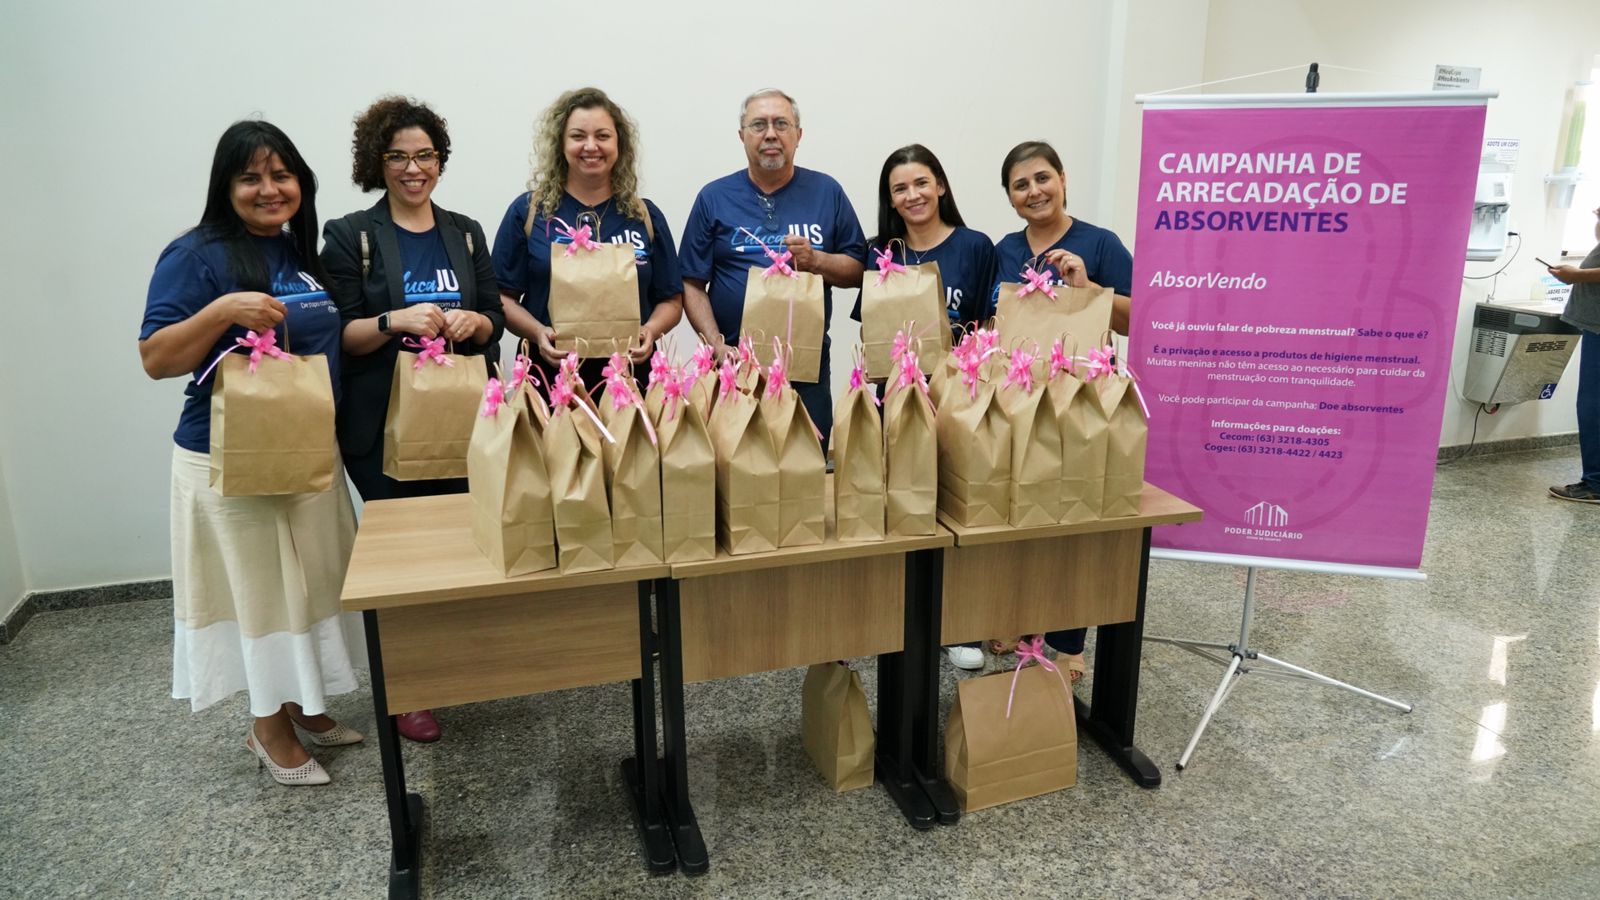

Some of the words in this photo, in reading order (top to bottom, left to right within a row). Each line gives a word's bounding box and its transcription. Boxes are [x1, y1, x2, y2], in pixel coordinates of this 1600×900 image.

[1158, 152, 1316, 174] CAMPANHA
[1323, 152, 1362, 174] DE
[1156, 178, 1362, 209] ARRECADAÇÃO
[1369, 182, 1408, 204] DE
[1154, 210, 1348, 232] ABSORVENTES
[1149, 270, 1267, 290] AbsorVendo
[1152, 320, 1174, 330] Você
[1176, 322, 1185, 332] já
[1187, 322, 1215, 331] ouviu
[1216, 323, 1240, 332] falar
[1241, 324, 1254, 333] de
[1256, 325, 1296, 335] pobreza
[1299, 327, 1356, 337] menstrual?
[1358, 328, 1381, 338] Sabe
[1394, 332, 1414, 340] que
[1417, 330, 1428, 339] é?
[1153, 344, 1159, 354] É
[1169, 346, 1210, 357] privação
[1262, 350, 1307, 360] produtos
[1310, 352, 1322, 360] de
[1324, 352, 1362, 362] higiene
[1365, 355, 1420, 364] menstrual.
[1147, 357, 1176, 367] Muitas
[1178, 359, 1216, 368] meninas
[1218, 360, 1235, 369] não
[1238, 361, 1255, 370] têm
[1258, 363, 1289, 372] acesso
[1305, 365, 1355, 374] necessário
[1356, 368, 1378, 376] para
[1380, 368, 1410, 377] cuidar
[1412, 369, 1425, 377] da
[1207, 372, 1266, 384] menstruação
[1291, 376, 1356, 387] tranquilidade.
[1158, 394, 1180, 403] Você
[1182, 395, 1205, 404] pode
[1207, 396, 1250, 406] participar
[1252, 398, 1263, 406] da
[1266, 399, 1317, 410] campanha:
[1320, 402, 1339, 410] Doe
[1341, 403, 1404, 414] absorventes
[1211, 420, 1270, 432] Informações
[1297, 425, 1341, 435] doações:
[1220, 432, 1254, 441] Cecom:
[1256, 434, 1275, 444] (63)
[1278, 436, 1329, 446] 3218-4305
[1204, 443, 1236, 453] Coges:
[1238, 445, 1256, 454] (63)
[1258, 446, 1310, 457] 3218-4422
[1318, 450, 1343, 459] 4423
[1224, 526, 1252, 535] PODER
[1254, 529, 1303, 540] JUDICIÁRIO
